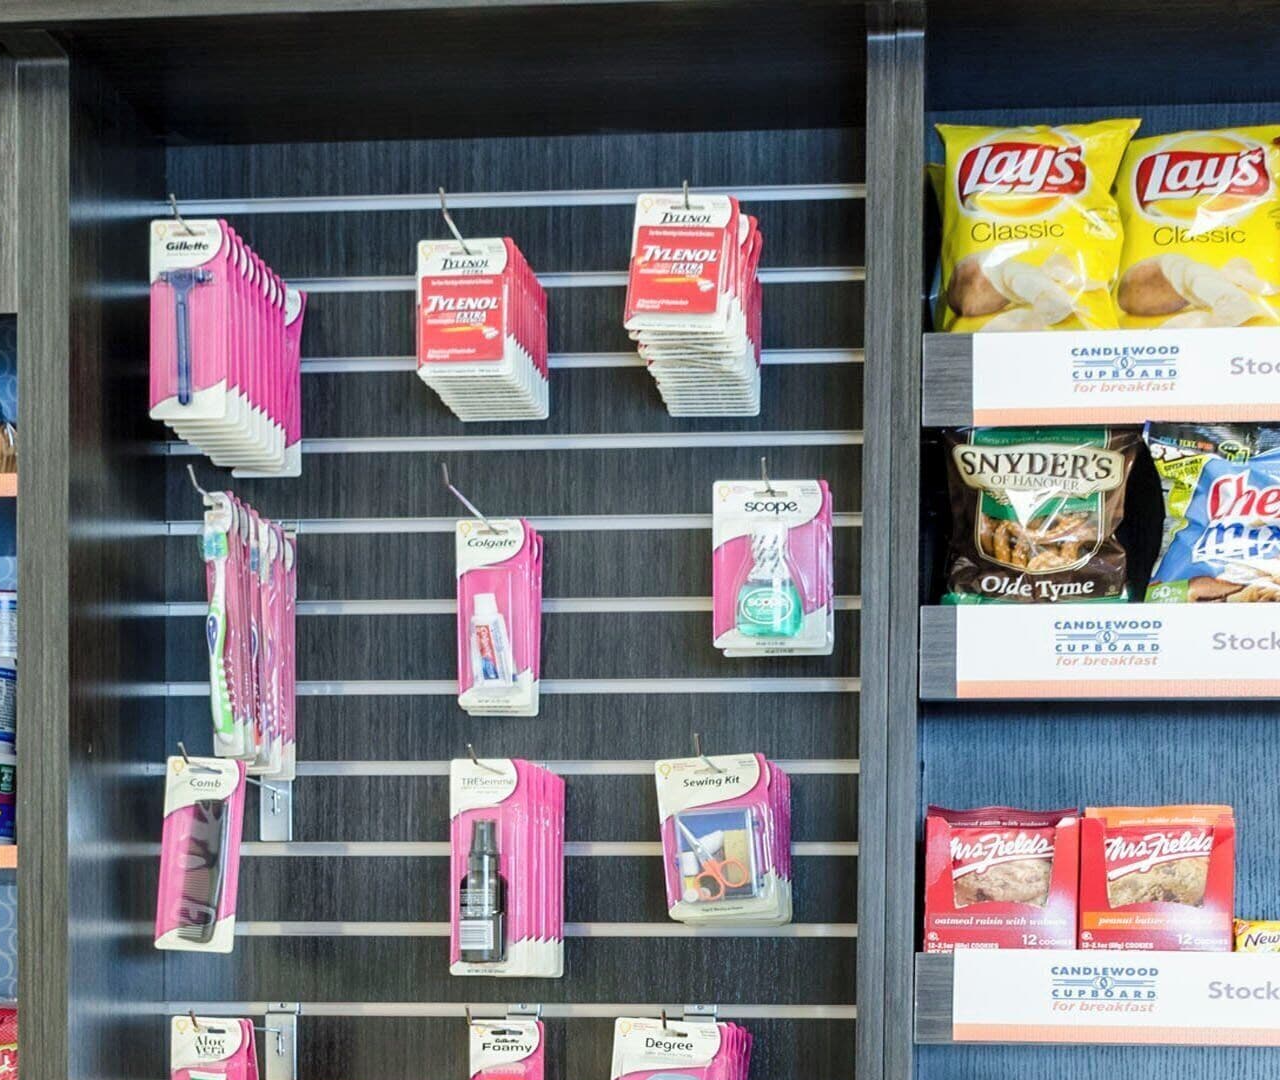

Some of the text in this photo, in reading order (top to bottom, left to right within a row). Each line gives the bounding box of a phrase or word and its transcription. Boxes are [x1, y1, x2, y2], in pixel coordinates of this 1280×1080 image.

[963, 143, 1082, 196] Lay's
[1143, 146, 1261, 202] Lay's
[970, 220, 1065, 243] Classic
[1152, 225, 1247, 247] Classic
[165, 241, 210, 252] Gillette
[642, 244, 718, 264] TYLENOL
[426, 295, 499, 314] TYLENOL
[1070, 345, 1181, 357] CANDLEWOOD
[1071, 368, 1178, 380] CUPBOARD
[1072, 380, 1177, 394] for breakfast
[960, 449, 1114, 480] SNYDER'S
[744, 500, 799, 515] scope
[466, 536, 517, 549] Colgate
[980, 574, 1096, 601] Olde Tyme
[682, 775, 740, 788] Sewing Kit
[1207, 980, 1280, 1001] Stock
[481, 1042, 533, 1054] Foamy
[644, 1036, 694, 1053] Degree
